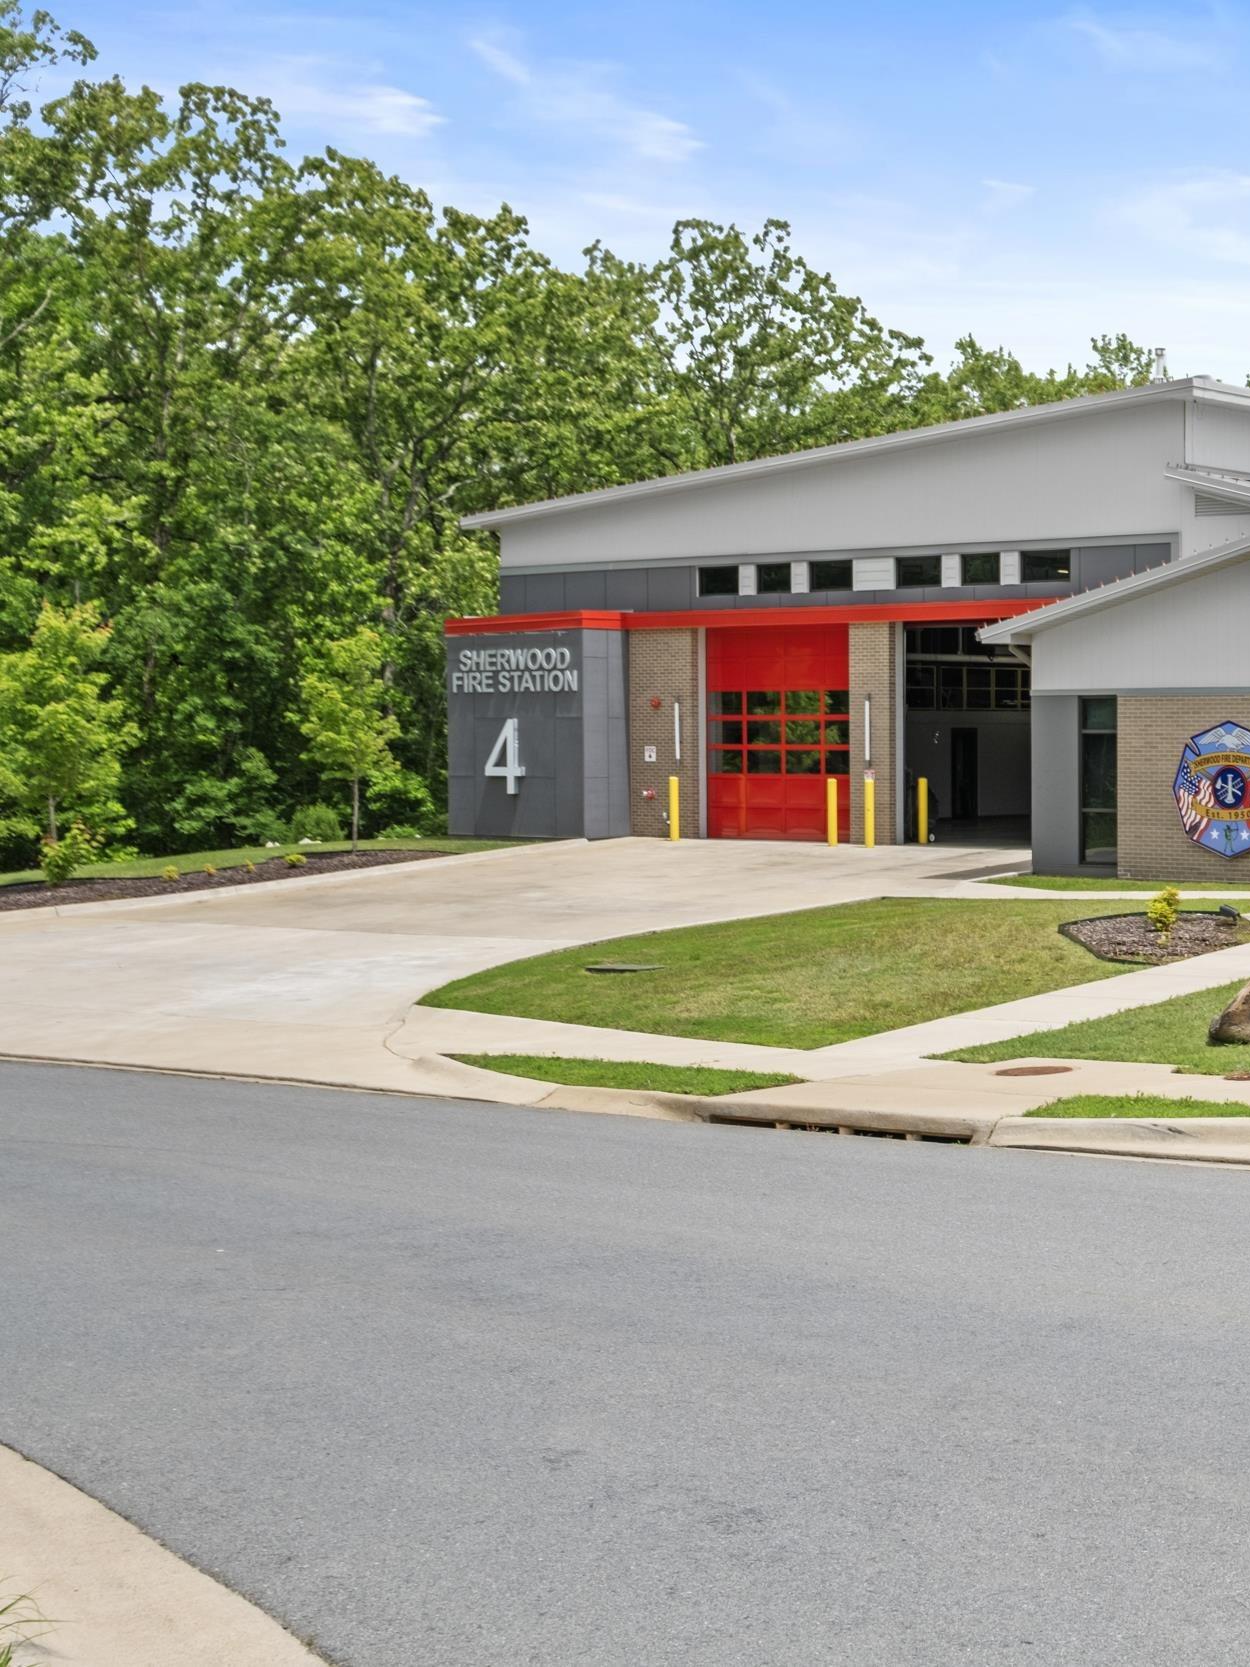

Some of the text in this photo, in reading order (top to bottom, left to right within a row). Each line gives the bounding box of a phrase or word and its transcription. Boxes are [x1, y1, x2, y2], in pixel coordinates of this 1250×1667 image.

[459, 647, 570, 671] SHERWOOD
[452, 670, 578, 693] FIRE STATION
[484, 718, 526, 795] 4
[1194, 754, 1221, 768] SHERWOOD
[1221, 754, 1231, 763] FIRE
[1206, 808, 1250, 820] Est. 1950
